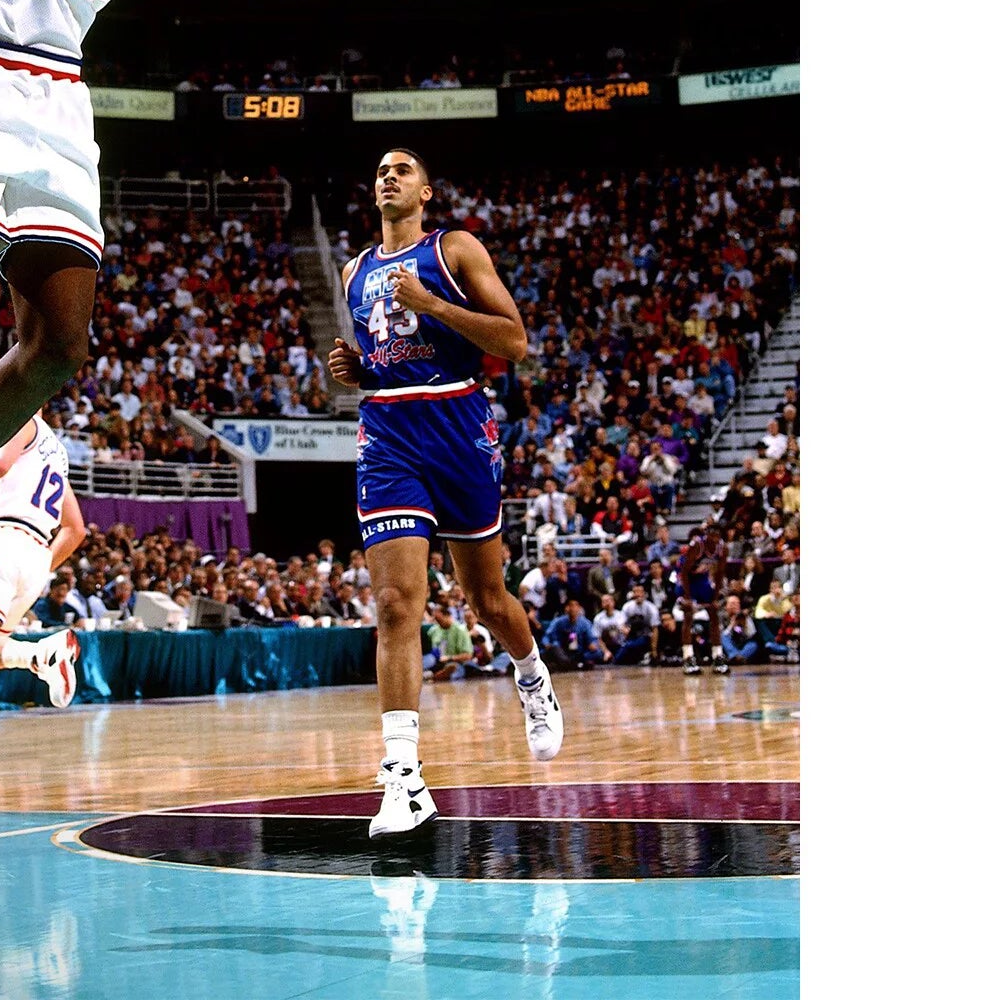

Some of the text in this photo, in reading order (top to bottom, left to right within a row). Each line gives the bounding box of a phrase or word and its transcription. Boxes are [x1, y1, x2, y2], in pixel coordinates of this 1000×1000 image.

[244, 96, 300, 118] 5:08
[525, 81, 649, 103] NBA ALL-STAR
[368, 299, 419, 344] 43
[31, 464, 64, 520] 12
